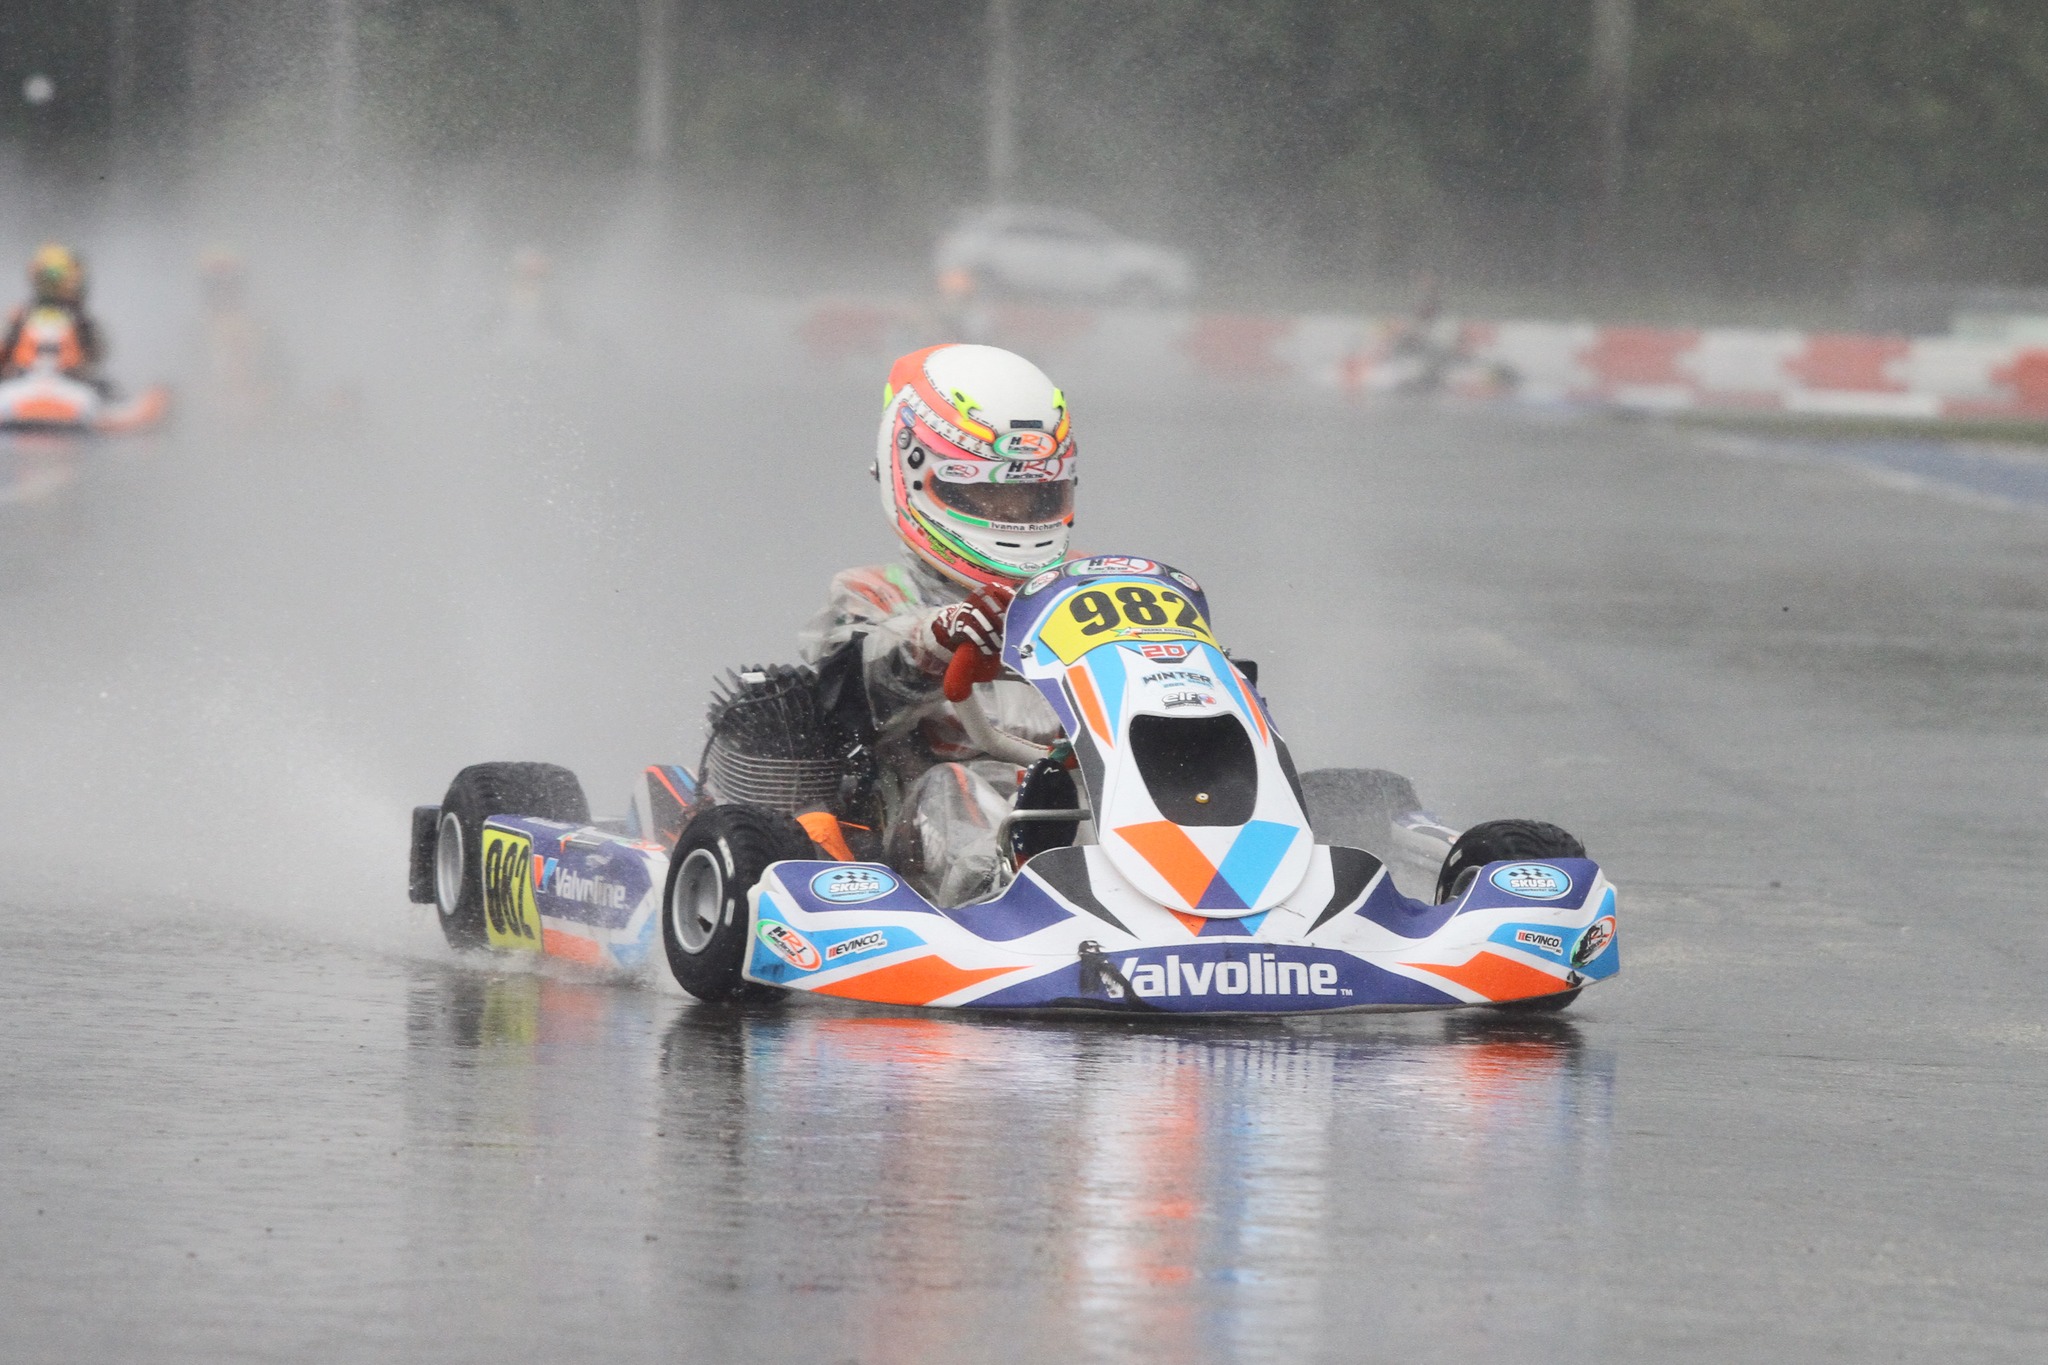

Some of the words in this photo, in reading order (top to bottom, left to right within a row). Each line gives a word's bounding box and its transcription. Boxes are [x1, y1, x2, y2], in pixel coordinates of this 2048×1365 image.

[991, 522, 1025, 531] Ivanna
[1069, 586, 1210, 639] 982
[1142, 671, 1212, 685] WINTER
[1161, 691, 1199, 704] elf
[829, 881, 880, 893] SKUSA
[1509, 879, 1557, 889] SKUSA
[835, 933, 880, 955] EVINCO
[1524, 932, 1560, 947] EVINCO
